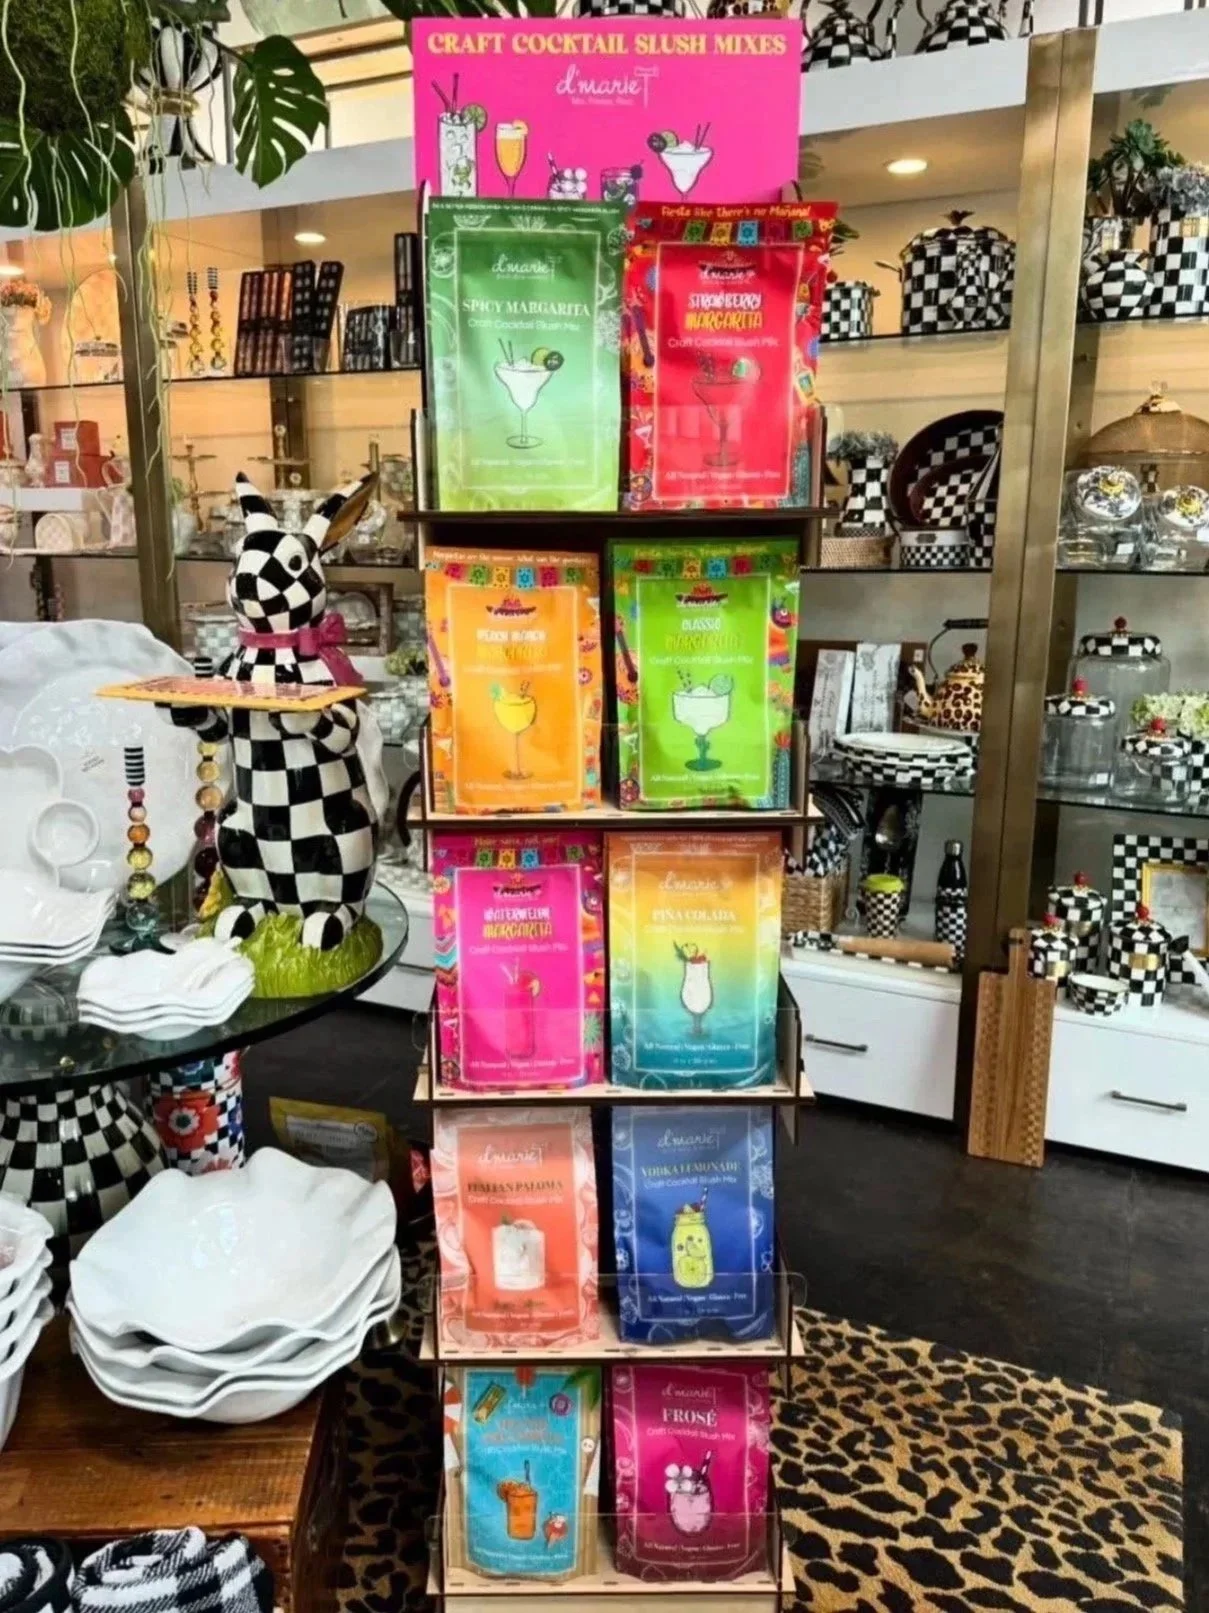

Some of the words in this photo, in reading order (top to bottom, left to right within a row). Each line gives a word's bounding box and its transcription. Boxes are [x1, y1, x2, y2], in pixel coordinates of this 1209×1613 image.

[428, 33, 505, 54] CRAFT
[512, 33, 629, 54] COCKTAIL
[635, 33, 706, 54] SLUSH
[713, 33, 787, 55] MIXES
[661, 205, 691, 217] Fiesta
[716, 205, 750, 218] there's
[754, 207, 766, 217] no
[462, 299, 502, 313] SPICY
[506, 301, 591, 317] MARGARITA
[687, 292, 762, 310] STRAWBERRY
[684, 311, 763, 332] MARGARITA
[681, 617, 721, 631] CLASSIC
[684, 908, 737, 921] COLADA
[483, 922, 553, 940] MARGARITA
[641, 1165, 679, 1177] VODKA
[680, 1161, 740, 1174] LEMONADE
[467, 1182, 514, 1193] ITALIAN
[515, 1180, 564, 1192] PALOMA
[662, 1407, 718, 1427] FROSÉ
